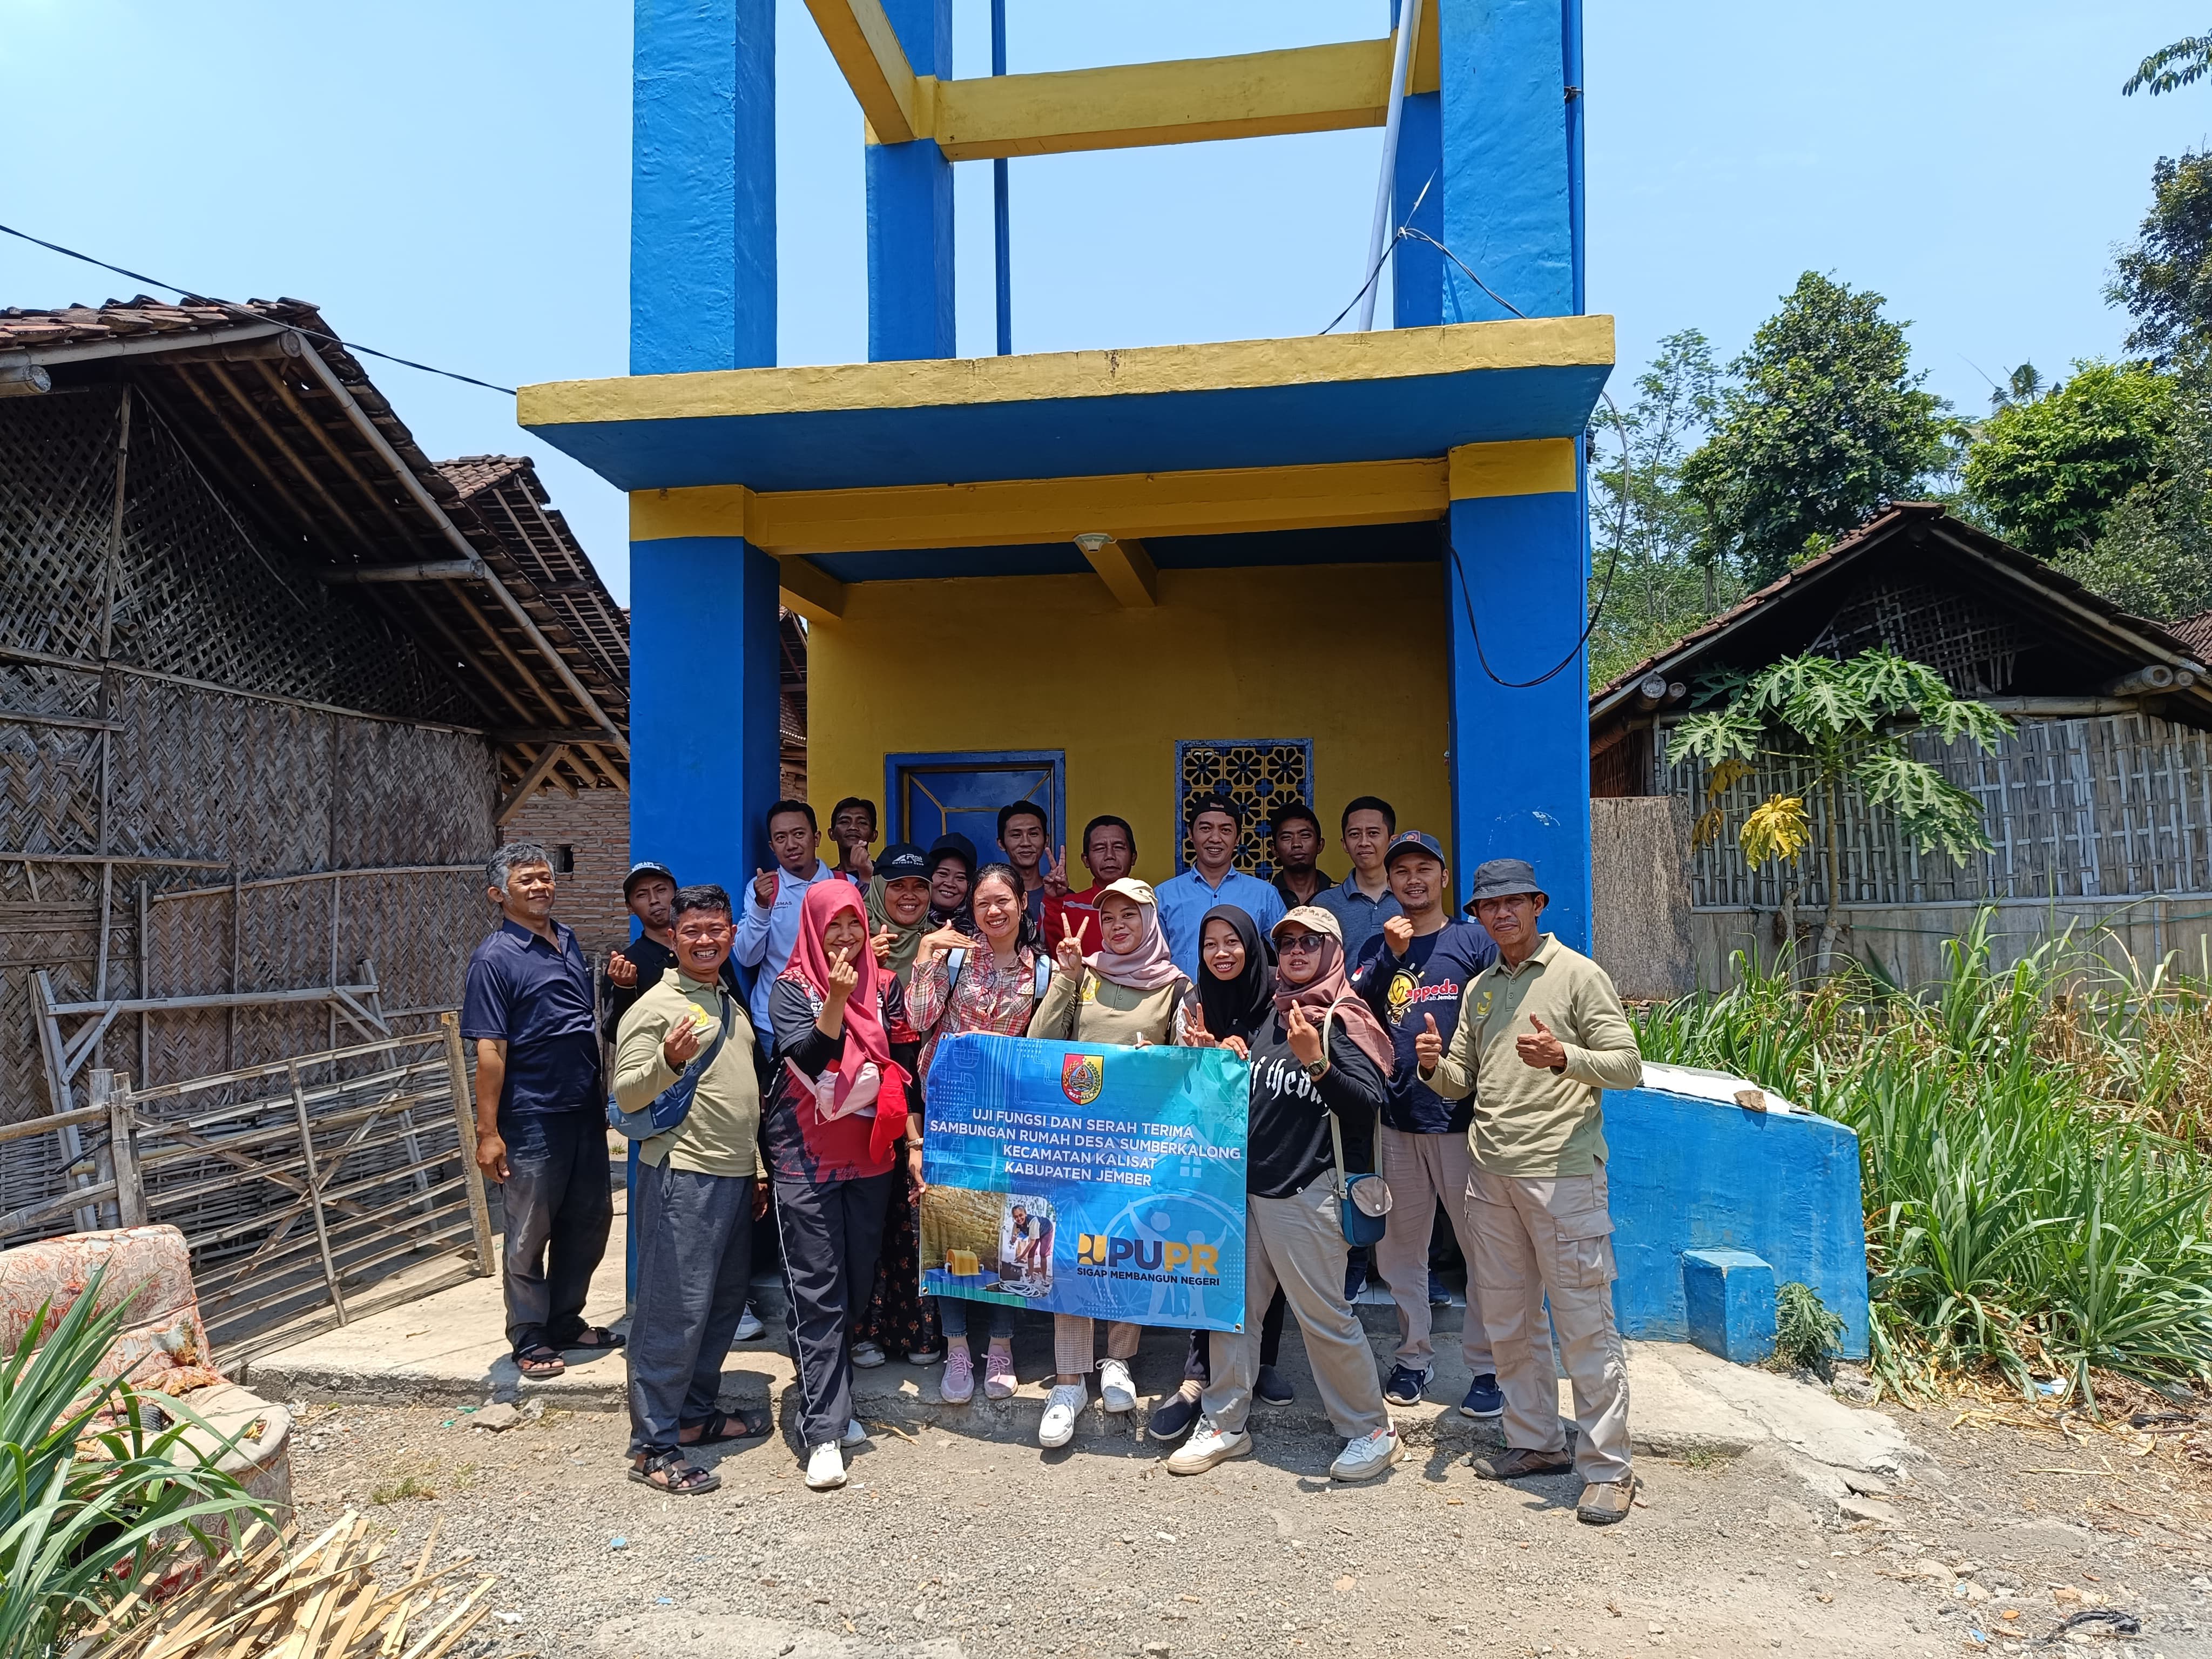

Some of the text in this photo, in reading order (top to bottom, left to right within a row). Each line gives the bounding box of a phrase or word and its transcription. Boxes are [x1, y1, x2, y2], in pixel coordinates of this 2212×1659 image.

[973, 1108, 1194, 1138] UJI FUNGSI DAN SERAH TERIMA
[930, 1120, 1241, 1159] SAMBUNGAN RUMAH DESA SUMBERKALONG
[1003, 1144, 1157, 1169] KECAMATAN KALISAT
[1004, 1161, 1151, 1186] KABUPATEN JEMBER
[1109, 1236, 1218, 1275] PUPR
[1077, 1267, 1220, 1286] SIGAP MEMBANGUN NEGERI
